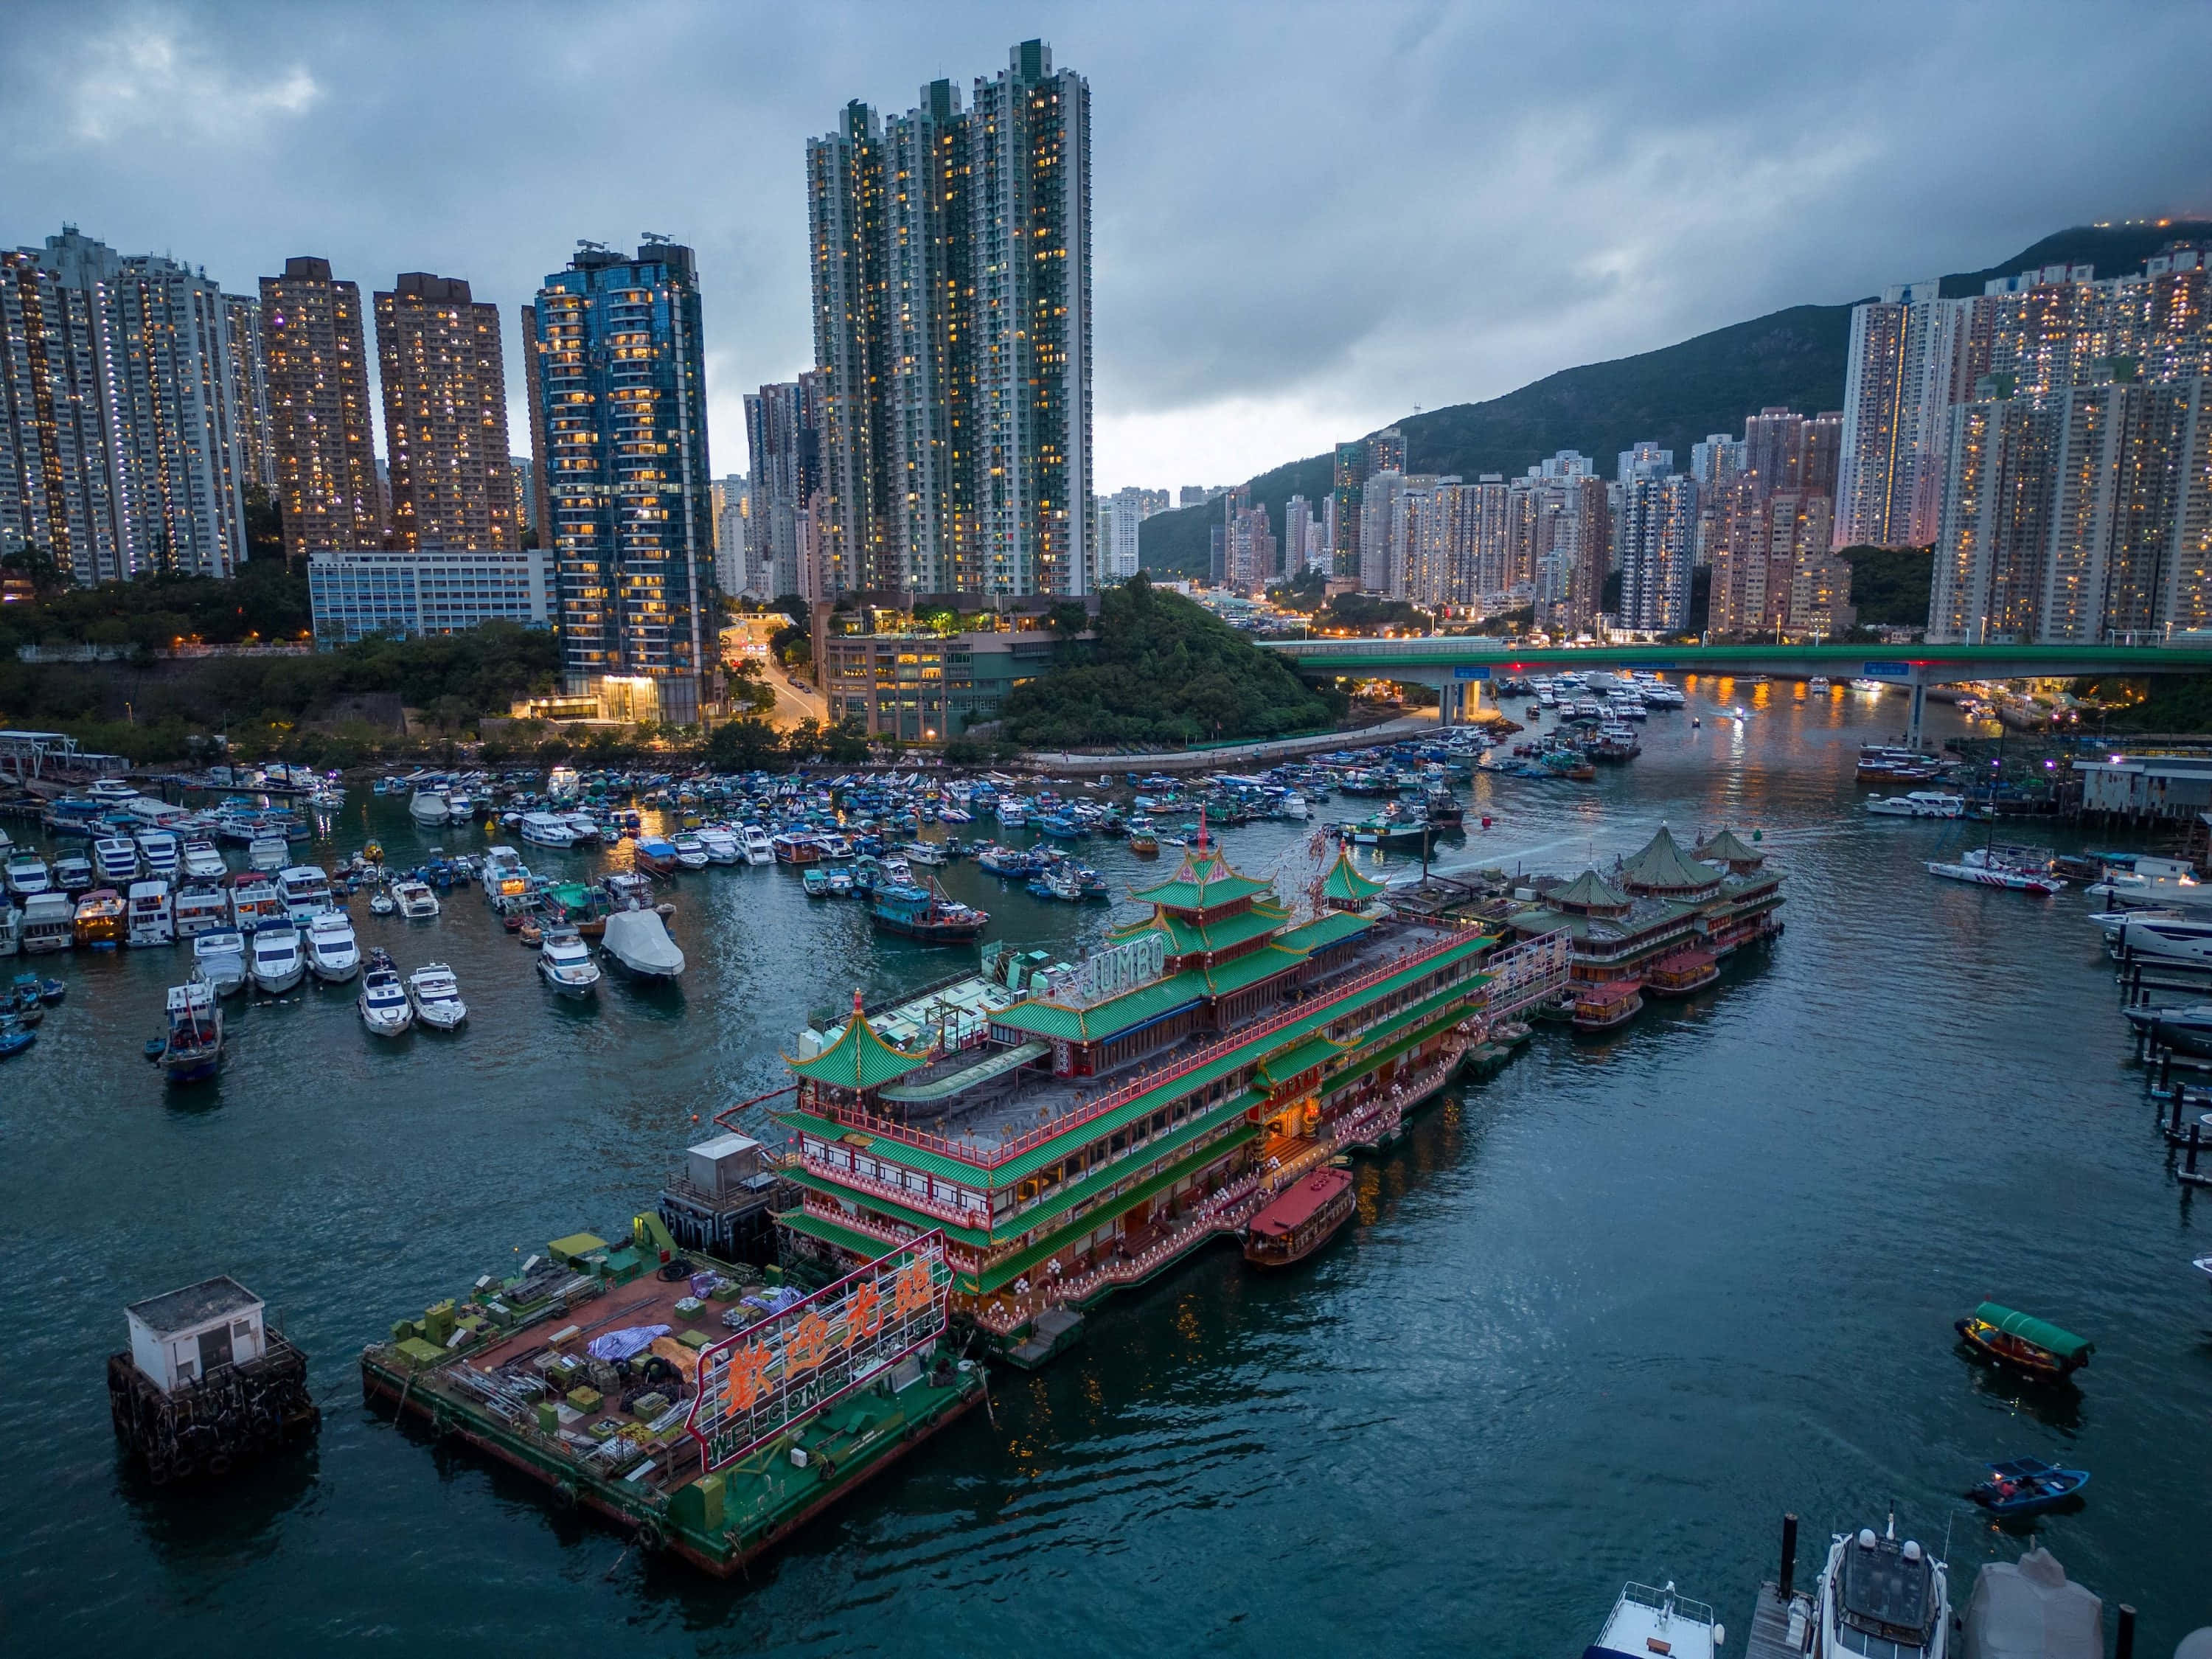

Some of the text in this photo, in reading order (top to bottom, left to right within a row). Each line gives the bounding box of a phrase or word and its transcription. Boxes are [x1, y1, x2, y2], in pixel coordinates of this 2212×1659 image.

[1082, 934, 1164, 998] JUMBO
[719, 1255, 933, 1416] 歡迎光臨
[709, 1366, 838, 1461] WELCOME
